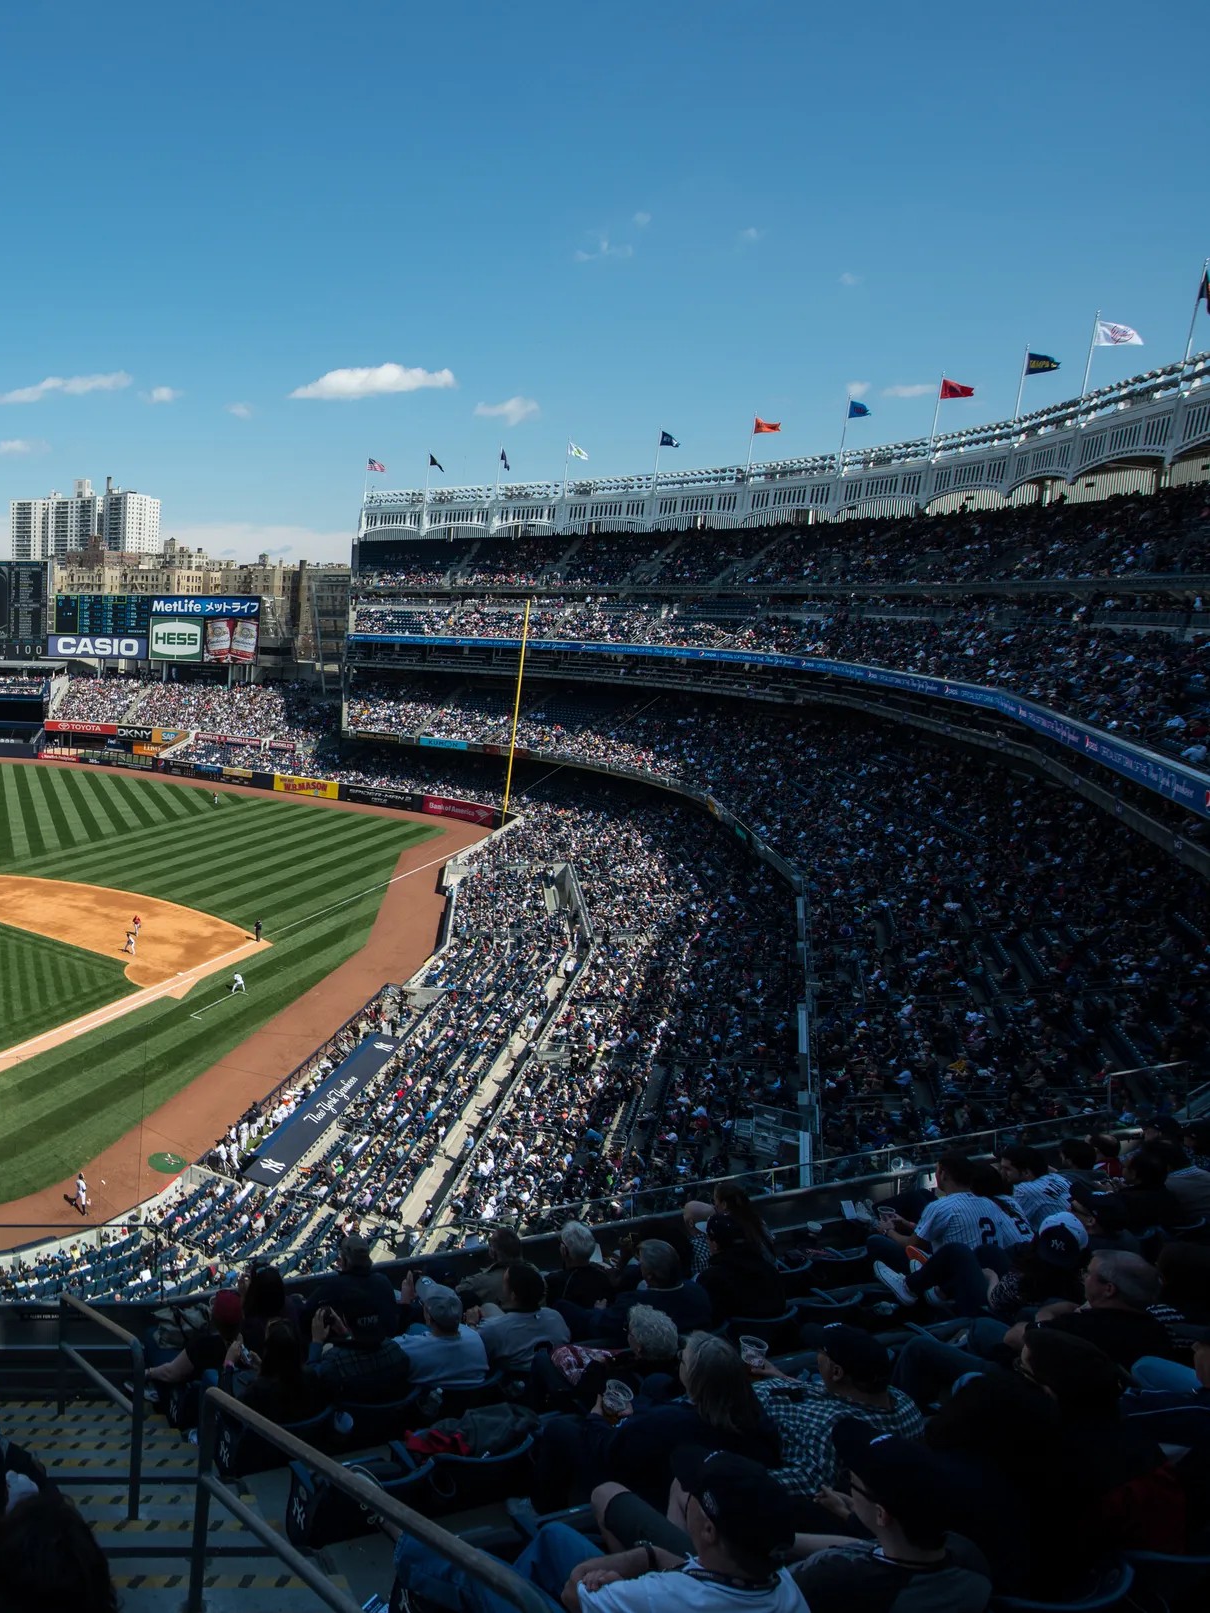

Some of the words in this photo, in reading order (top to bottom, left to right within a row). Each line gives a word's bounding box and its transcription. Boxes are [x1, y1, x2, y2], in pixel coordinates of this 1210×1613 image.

[152, 599, 201, 612] MetLife
[205, 602, 259, 613] メットライフ
[155, 632, 198, 645] HESS
[57, 637, 138, 656] CASIO
[118, 728, 151, 739] DKNY
[428, 740, 458, 748] KUMON
[350, 789, 404, 800] SPIDER-MAN
[429, 802, 444, 810] Bank
[451, 805, 475, 816] America
[303, 1109, 327, 1123] New
[316, 1094, 339, 1114] York
[329, 1076, 358, 1100] Yankees
[979, 1217, 998, 1246] 2
